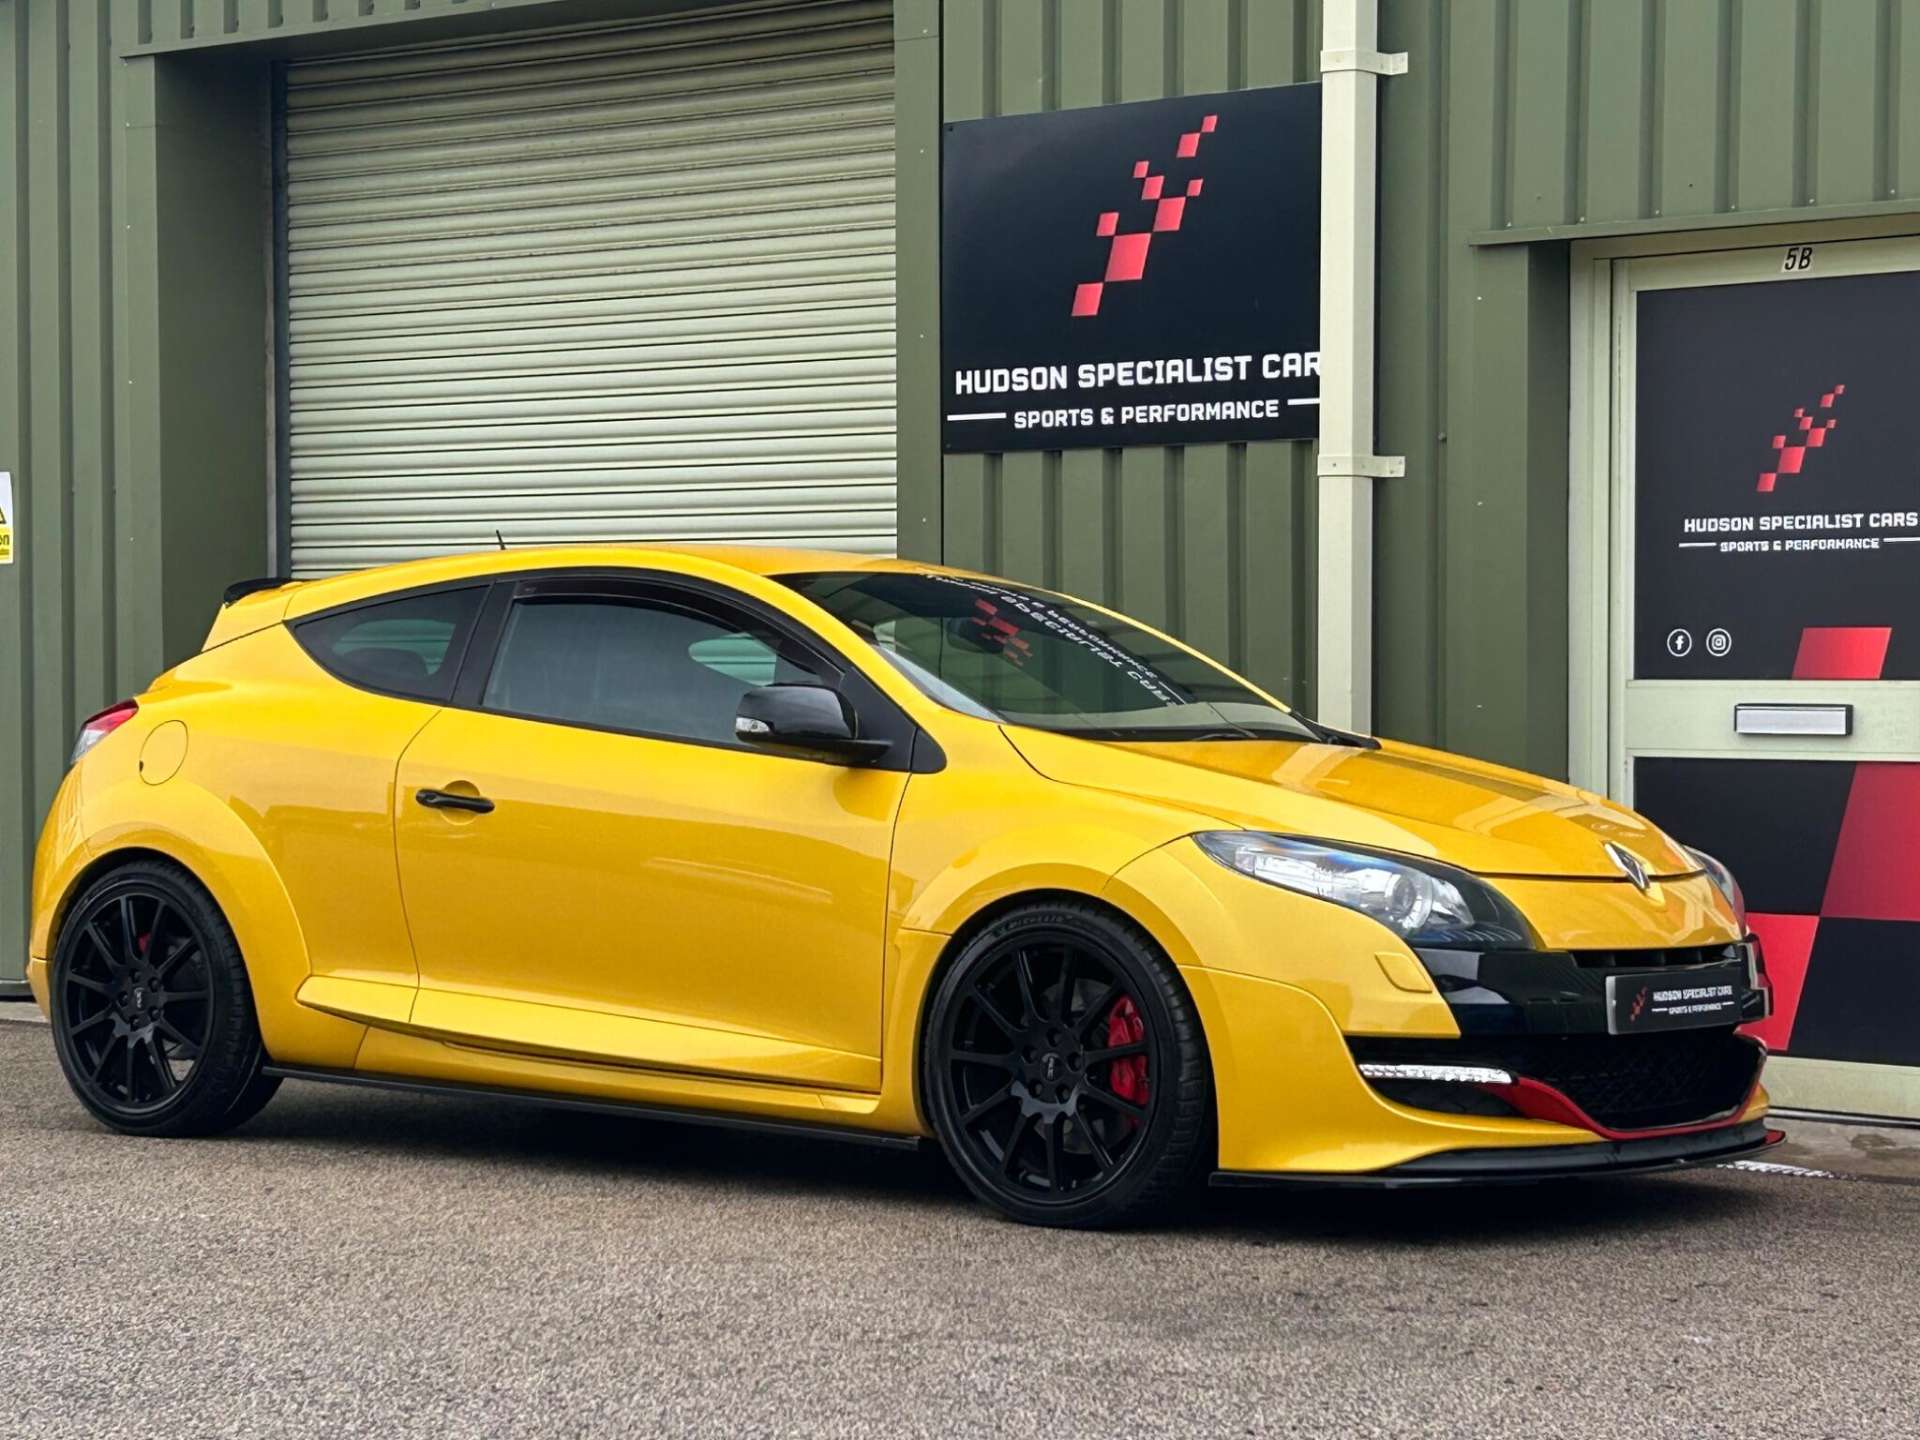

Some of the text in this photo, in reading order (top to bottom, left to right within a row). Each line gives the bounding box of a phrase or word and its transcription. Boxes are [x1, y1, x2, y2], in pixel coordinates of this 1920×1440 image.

[1784, 247, 1812, 270] 5B
[956, 364, 1068, 395] HUDSON
[1077, 355, 1253, 389] SPECIALIST
[1013, 399, 1280, 429] SPORTS & PERFORMANCE
[1683, 511, 1919, 533] HUDSON SPECIALIST CARS
[1720, 537, 1880, 552] SPORTS & PERFORMANCE
[1652, 990, 1682, 1002] HUDSON
